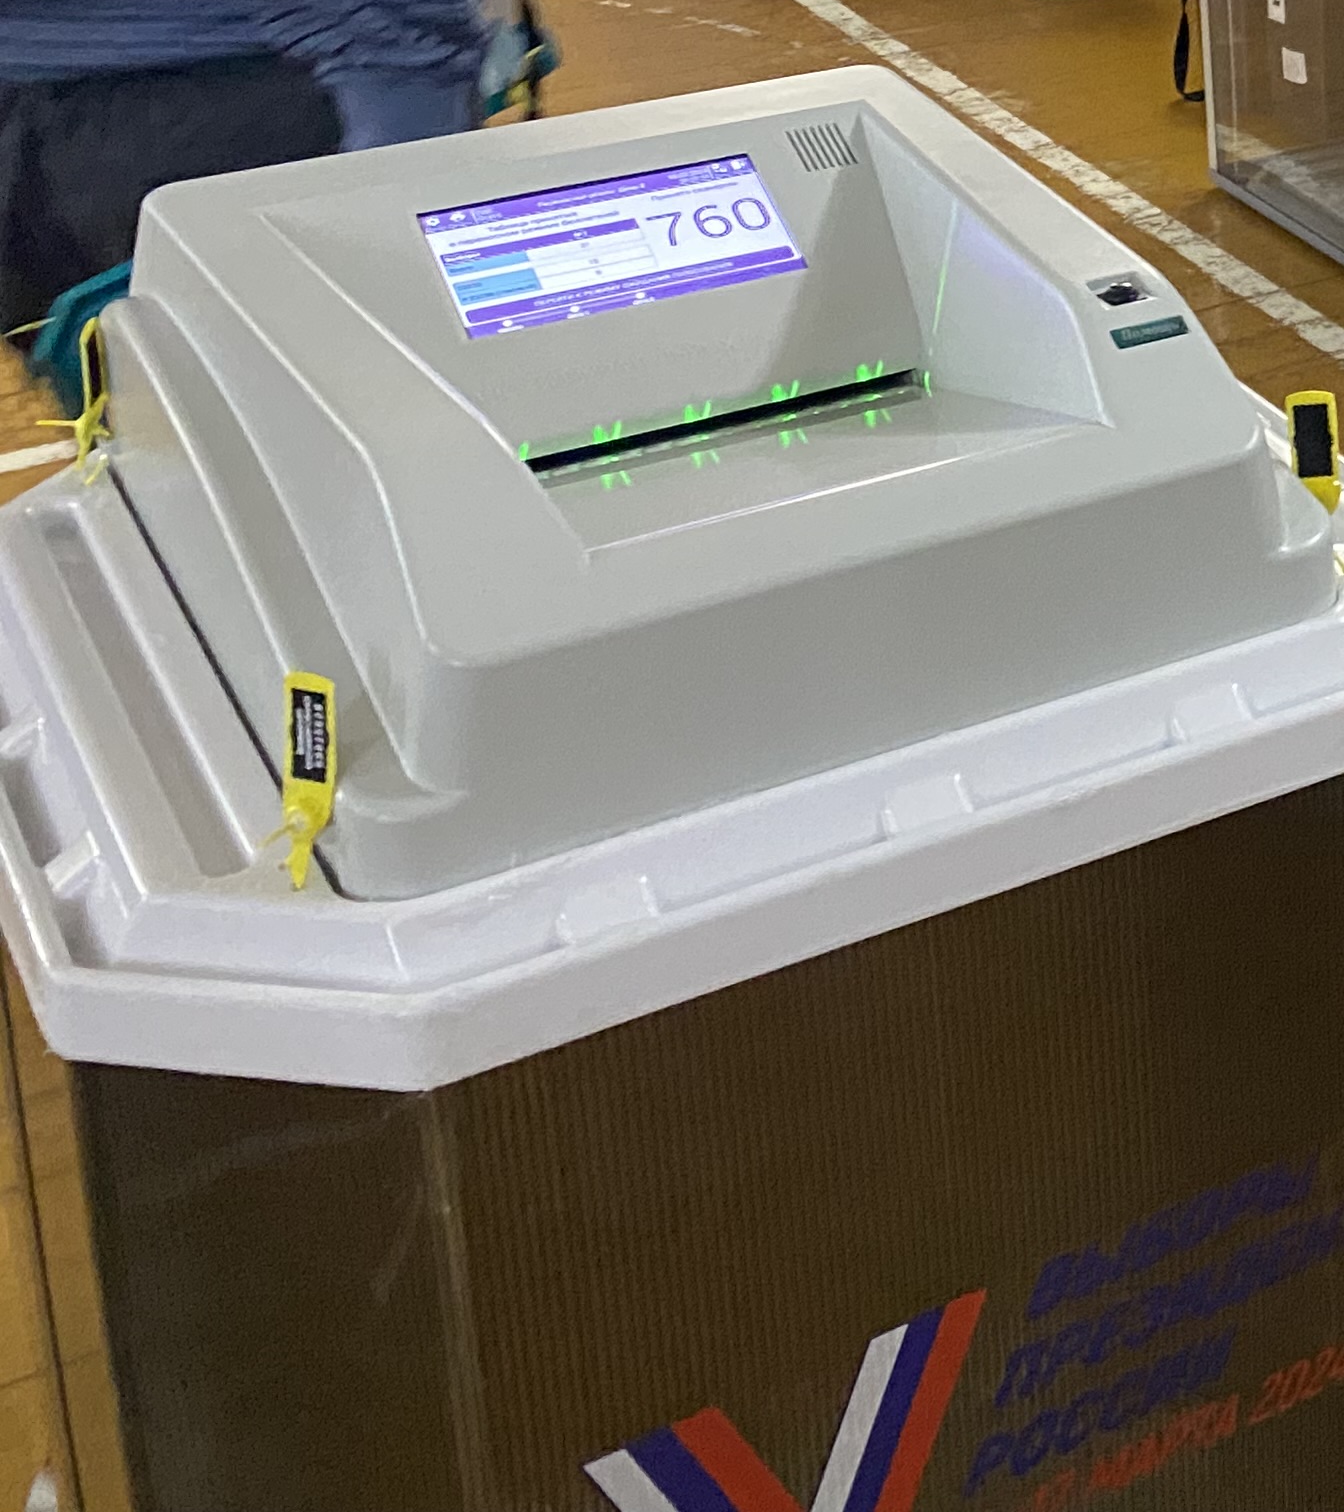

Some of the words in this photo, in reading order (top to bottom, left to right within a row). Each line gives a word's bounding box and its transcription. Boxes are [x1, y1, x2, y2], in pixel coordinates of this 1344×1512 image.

[646, 197, 771, 247] 760
[1026, 1143, 1320, 1320] ВЫБОРЫ
[963, 1321, 1239, 1498] РОССИИ
[1088, 1391, 1240, 1494] МАРТА
